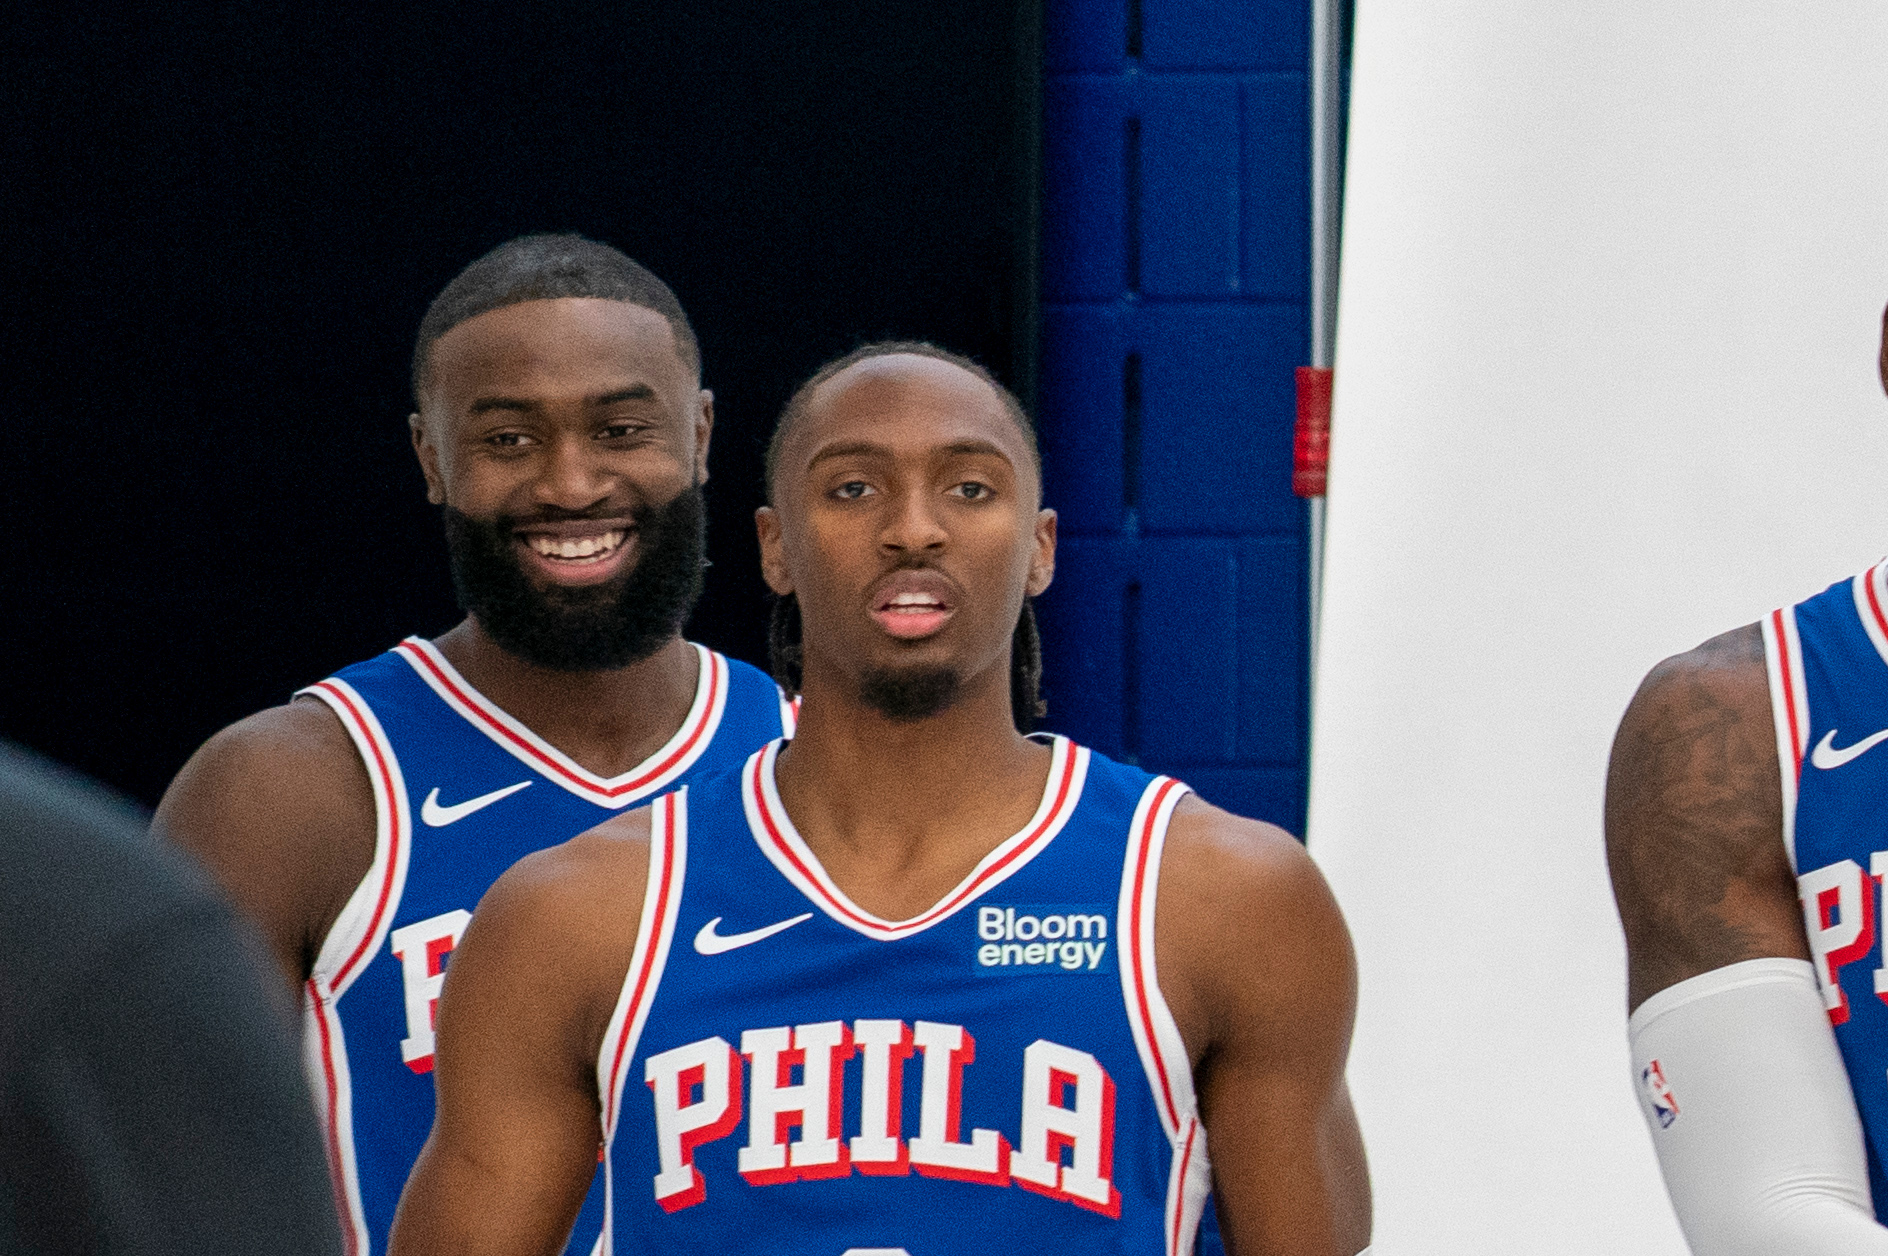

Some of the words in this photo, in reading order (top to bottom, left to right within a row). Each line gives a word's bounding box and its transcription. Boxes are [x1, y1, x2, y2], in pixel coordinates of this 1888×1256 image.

[978, 906, 1107, 941] Bloom
[977, 941, 1107, 970] energy
[644, 1019, 1122, 1219] PHILA
